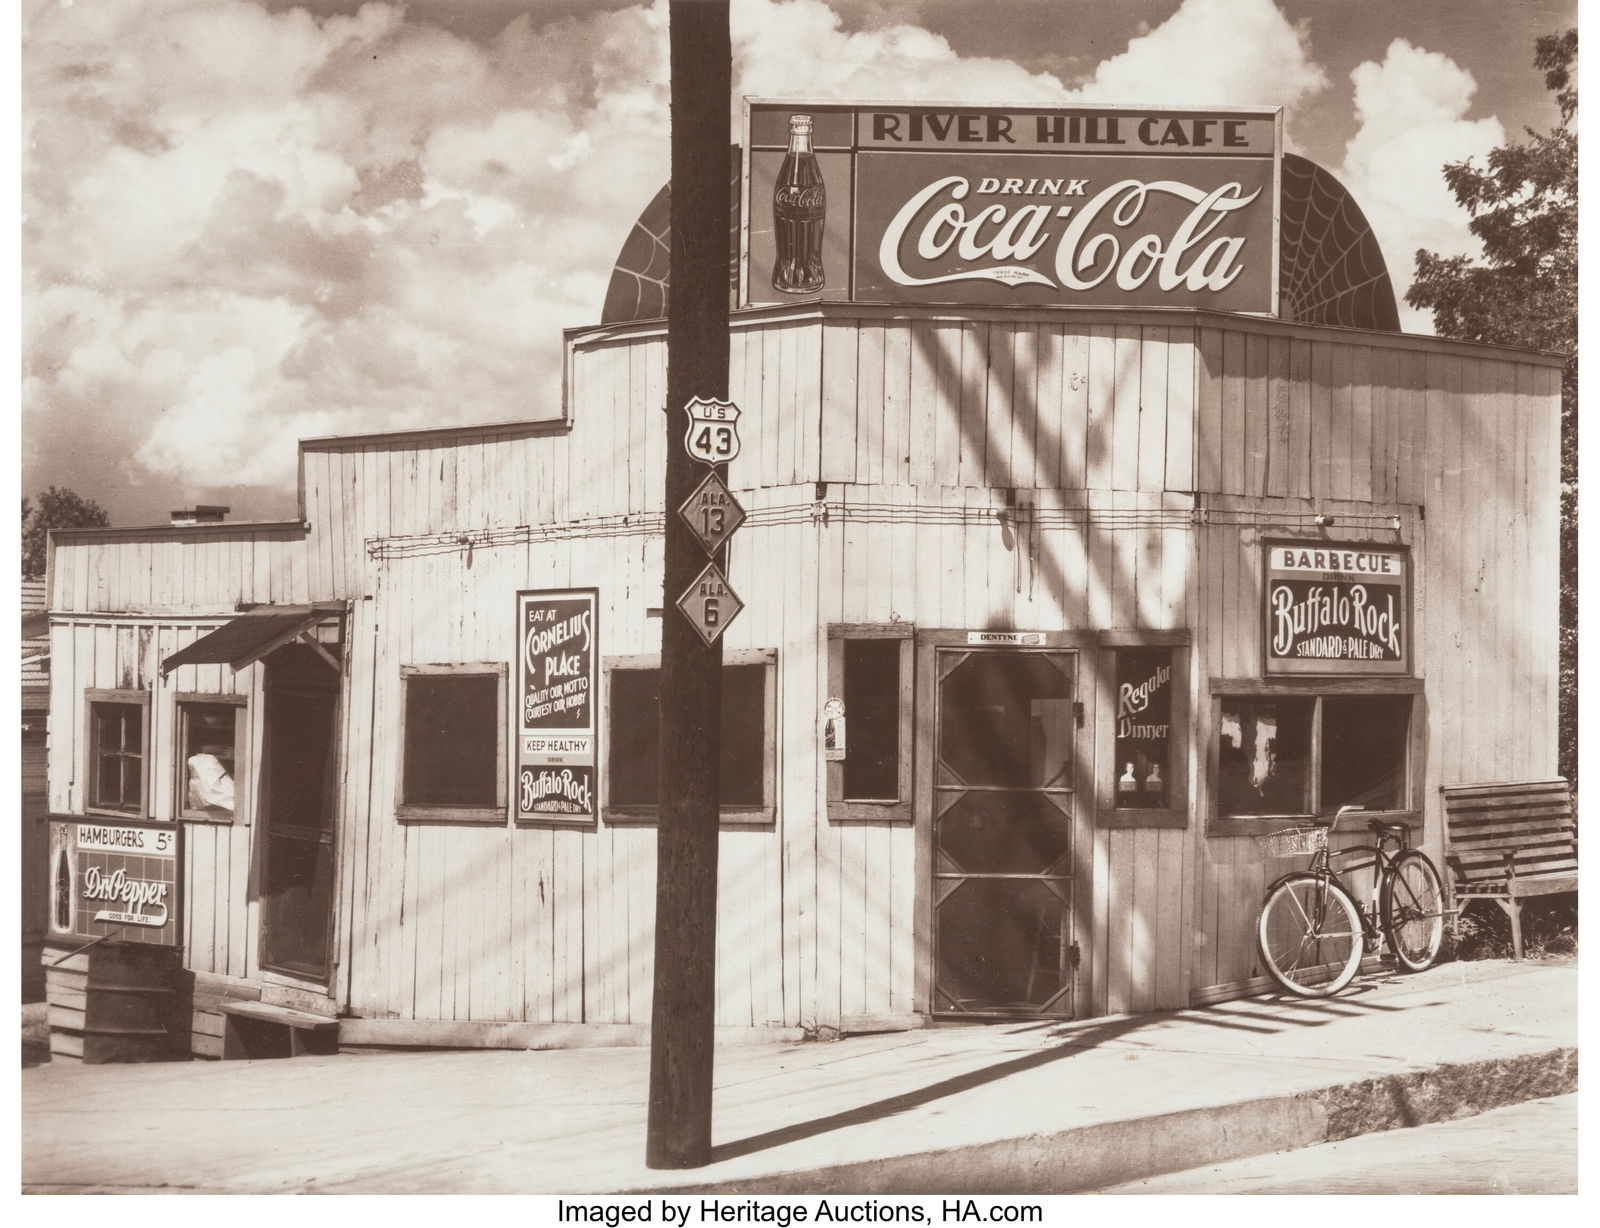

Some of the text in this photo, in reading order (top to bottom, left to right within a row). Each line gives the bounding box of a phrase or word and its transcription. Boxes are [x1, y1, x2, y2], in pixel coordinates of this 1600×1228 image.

[873, 113, 1250, 148] RIVER HILL CAFE
[976, 177, 1090, 196] DRINK
[878, 175, 1264, 293] Coca-Cola
[695, 426, 732, 455] 43
[701, 493, 730, 507] ALA.
[701, 508, 725, 537] 13
[1283, 550, 1392, 573] BARBECUE
[700, 582, 728, 597] ALA.
[1322, 572, 1356, 582] DRINK
[529, 609, 557, 622] EAT AT
[704, 598, 719, 626] 6
[1272, 584, 1399, 658] Buffalo Rock
[525, 610, 590, 675] CORNELIUS
[980, 633, 1018, 641] DENTYNE
[1296, 635, 1342, 658] STANDARD
[1348, 636, 1368, 659] PALE
[1369, 641, 1384, 660] DRY
[545, 650, 581, 686] PLACE
[525, 676, 588, 709] QUALITY OUR MOTTO
[1117, 665, 1171, 720] Regular
[525, 691, 587, 723] COURTESY OUR HOBBY
[1117, 716, 1169, 741] Dinner
[526, 739, 588, 752] KEEP HEALTHY
[520, 768, 592, 814] Buffalo Rock
[533, 800, 558, 812] STANDARD
[560, 800, 573, 813] PALE
[573, 803, 583, 813] DRY
[79, 826, 145, 849] HAMBURGERS
[108, 912, 122, 920] GOOD
